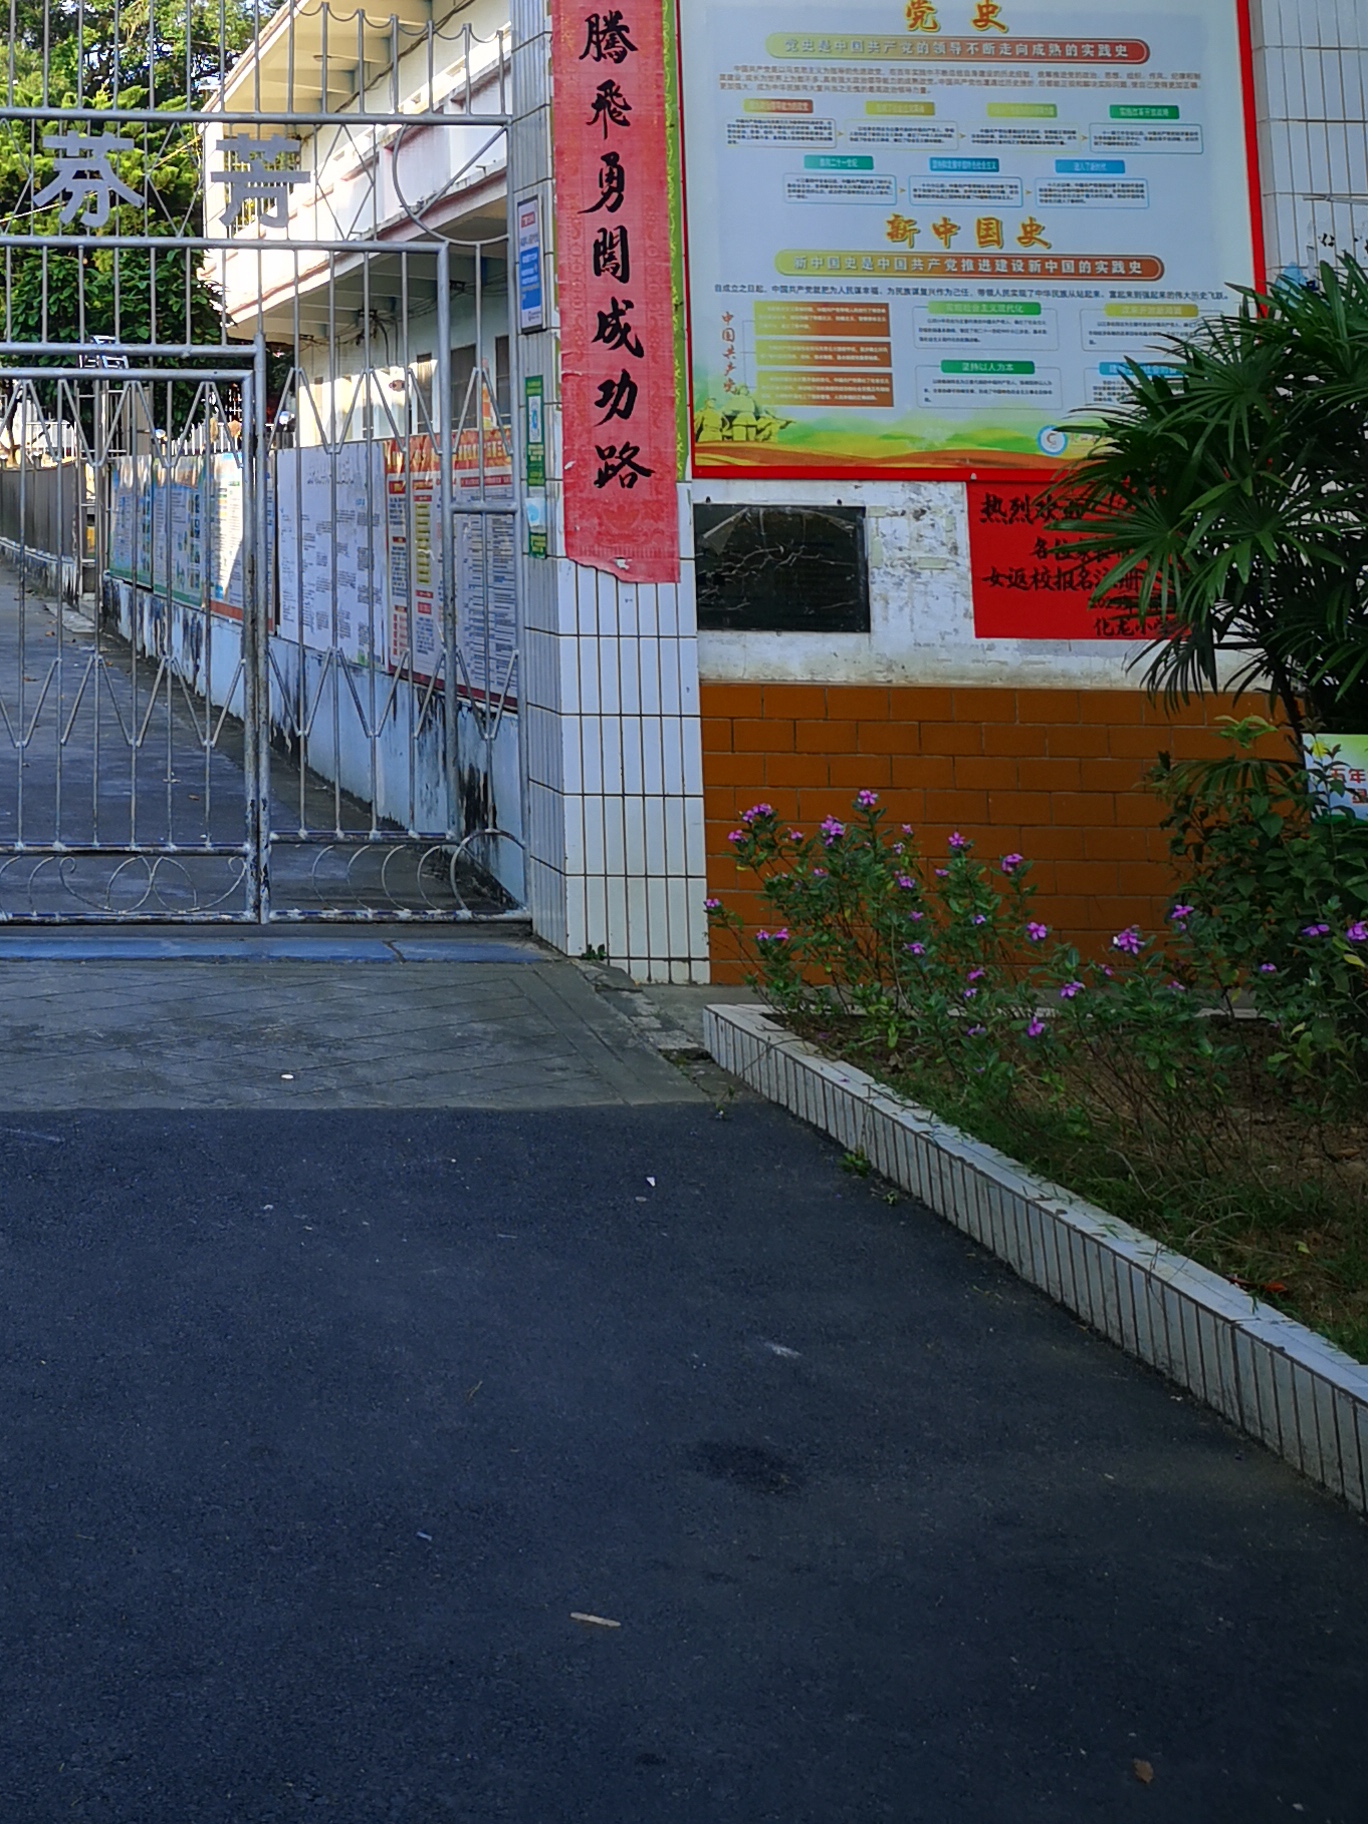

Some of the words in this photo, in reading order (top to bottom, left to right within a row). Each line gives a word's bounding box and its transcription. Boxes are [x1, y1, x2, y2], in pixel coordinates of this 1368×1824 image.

[785, 39, 1129, 58] 党史是中国共产党的领导不断走向成熟的实践史
[886, 213, 1052, 250] 新中国史
[794, 256, 1143, 275] 新中国史是中国共产党推进建设新中国的实践史
